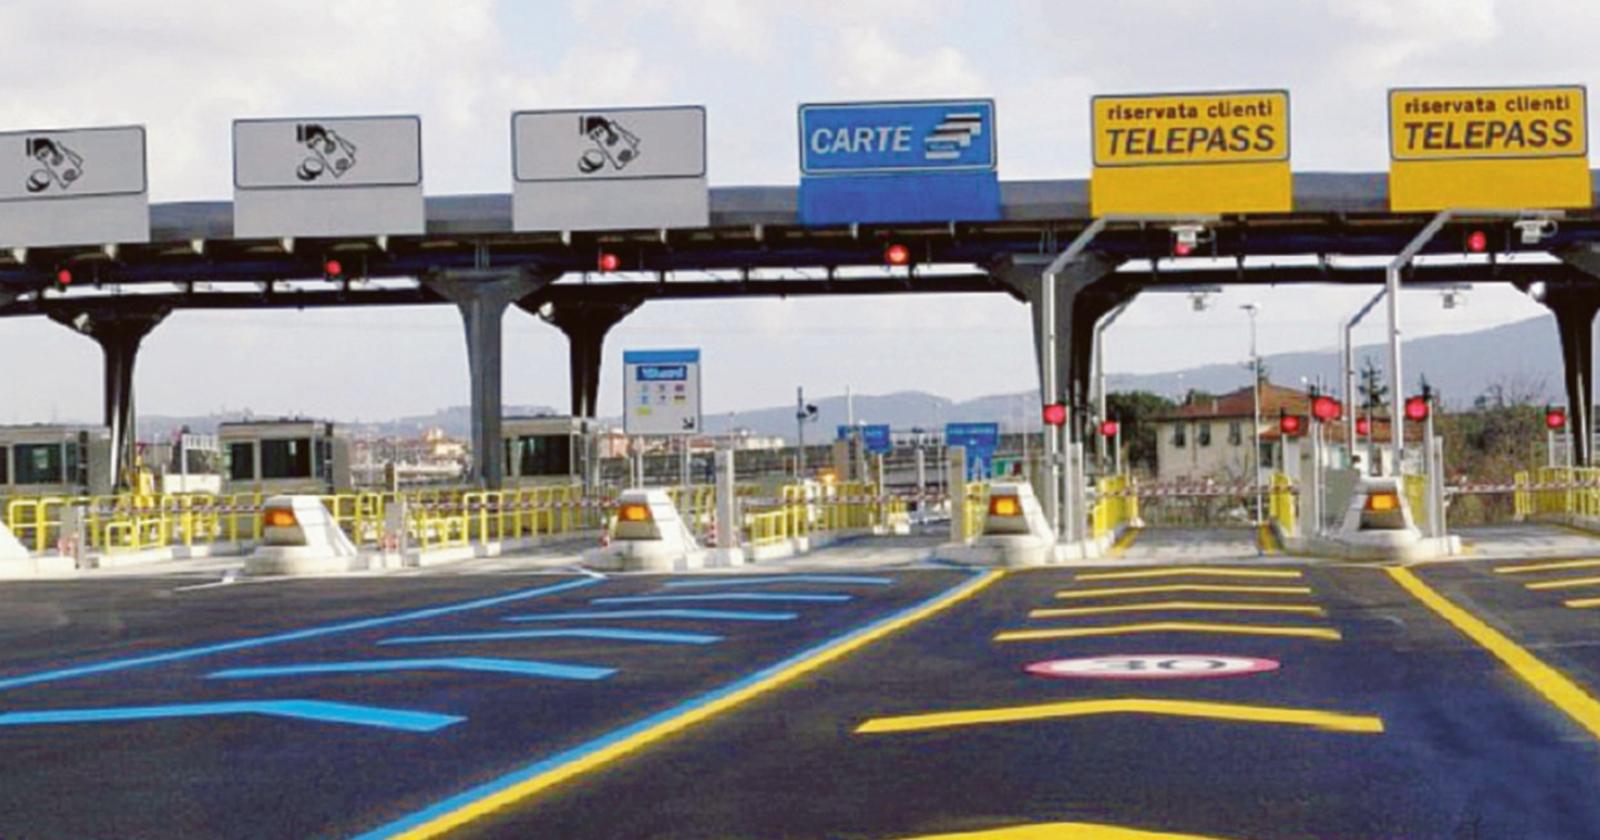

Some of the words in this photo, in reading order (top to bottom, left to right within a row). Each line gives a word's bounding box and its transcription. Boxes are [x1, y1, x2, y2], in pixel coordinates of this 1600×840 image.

[1108, 104, 1198, 120] riservata
[1207, 100, 1272, 118] clienti
[1405, 98, 1496, 114] riservata
[1505, 95, 1570, 112] clienti
[811, 127, 913, 154] CARTE
[1105, 124, 1275, 155] TELEPASS
[1404, 119, 1573, 149] TELEPASS
[1094, 658, 1227, 671] 30
